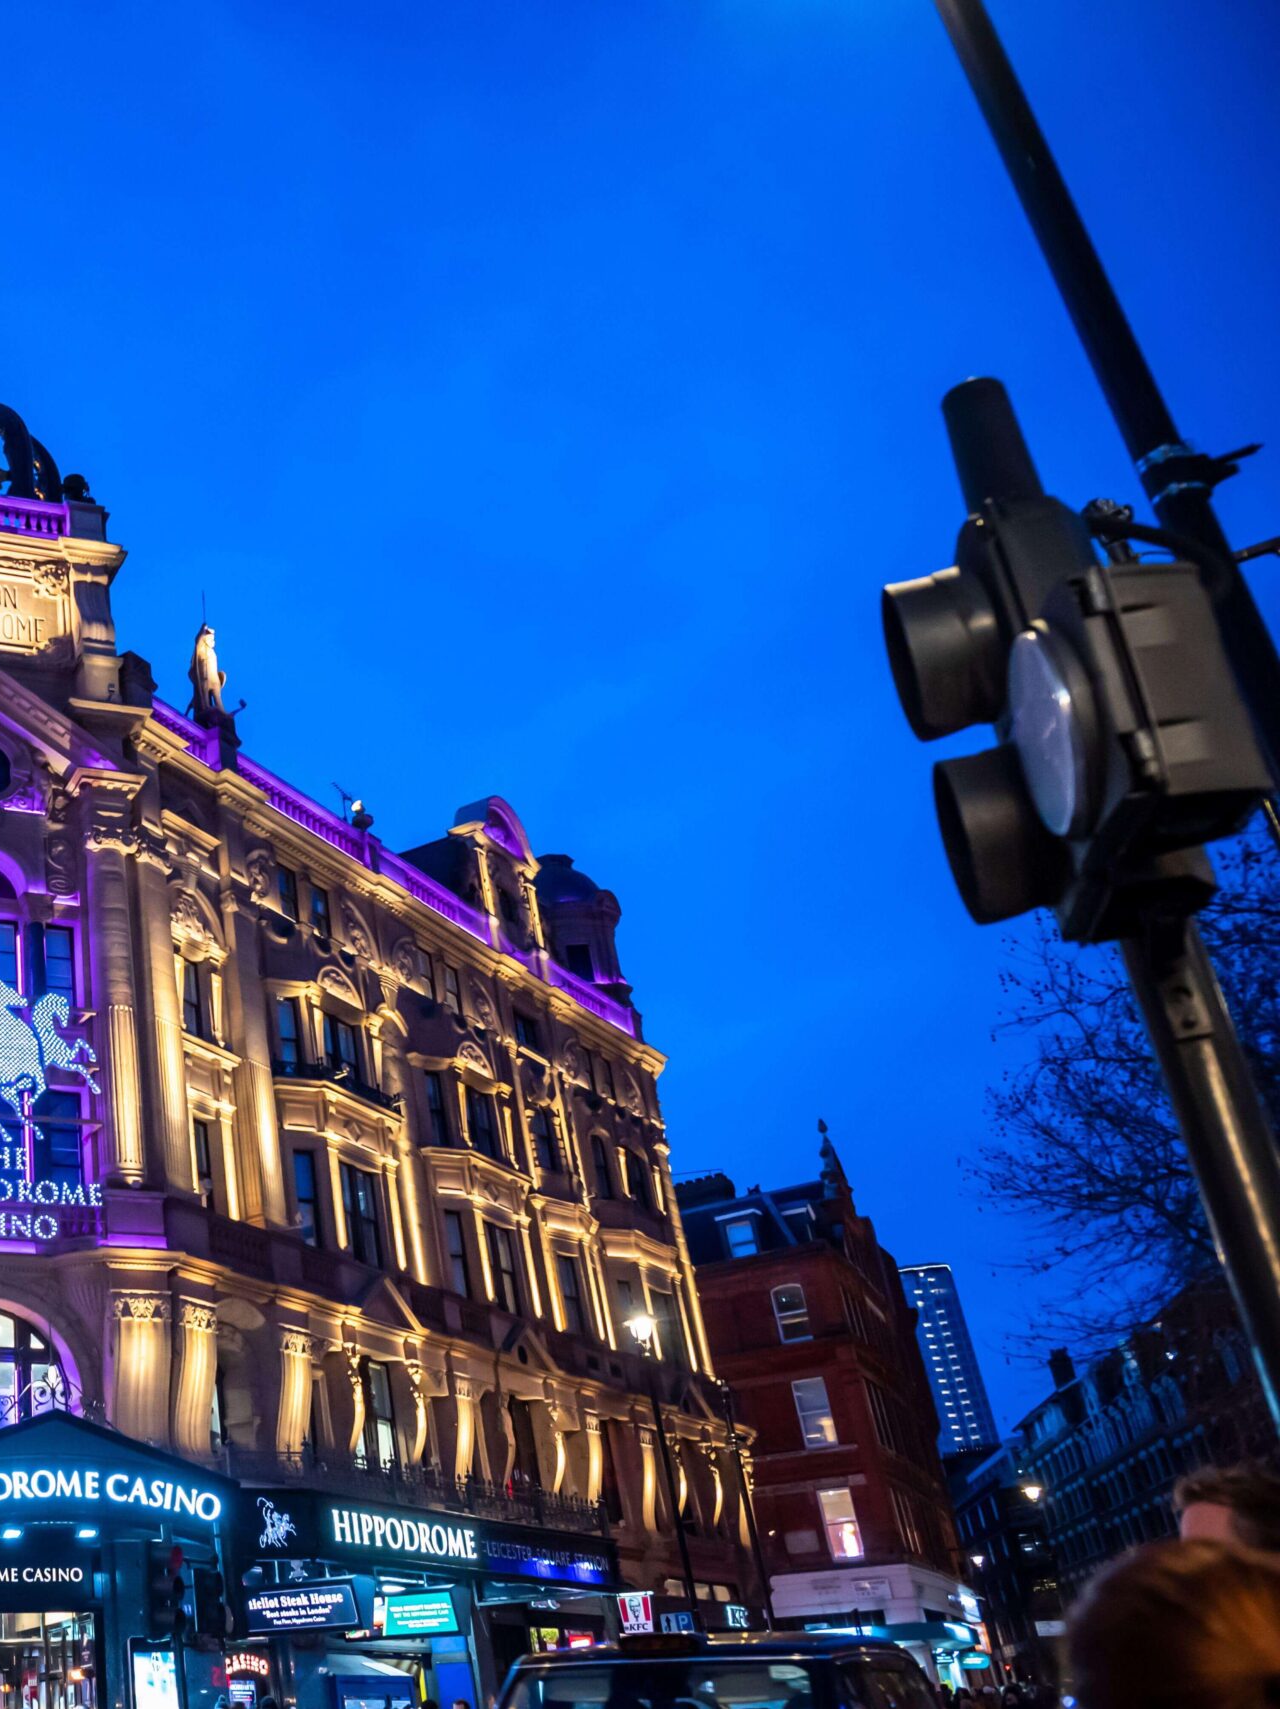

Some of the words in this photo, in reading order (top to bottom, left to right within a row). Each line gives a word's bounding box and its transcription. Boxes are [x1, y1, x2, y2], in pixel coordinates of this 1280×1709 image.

[106, 1474, 222, 1521] CASINO
[331, 1508, 478, 1559] HIPPODROME
[22, 1567, 84, 1583] CASINO
[280, 1593, 309, 1608] Steak
[309, 1592, 344, 1605] House
[628, 1622, 649, 1632] KFC
[225, 1653, 269, 1676] CASINO
